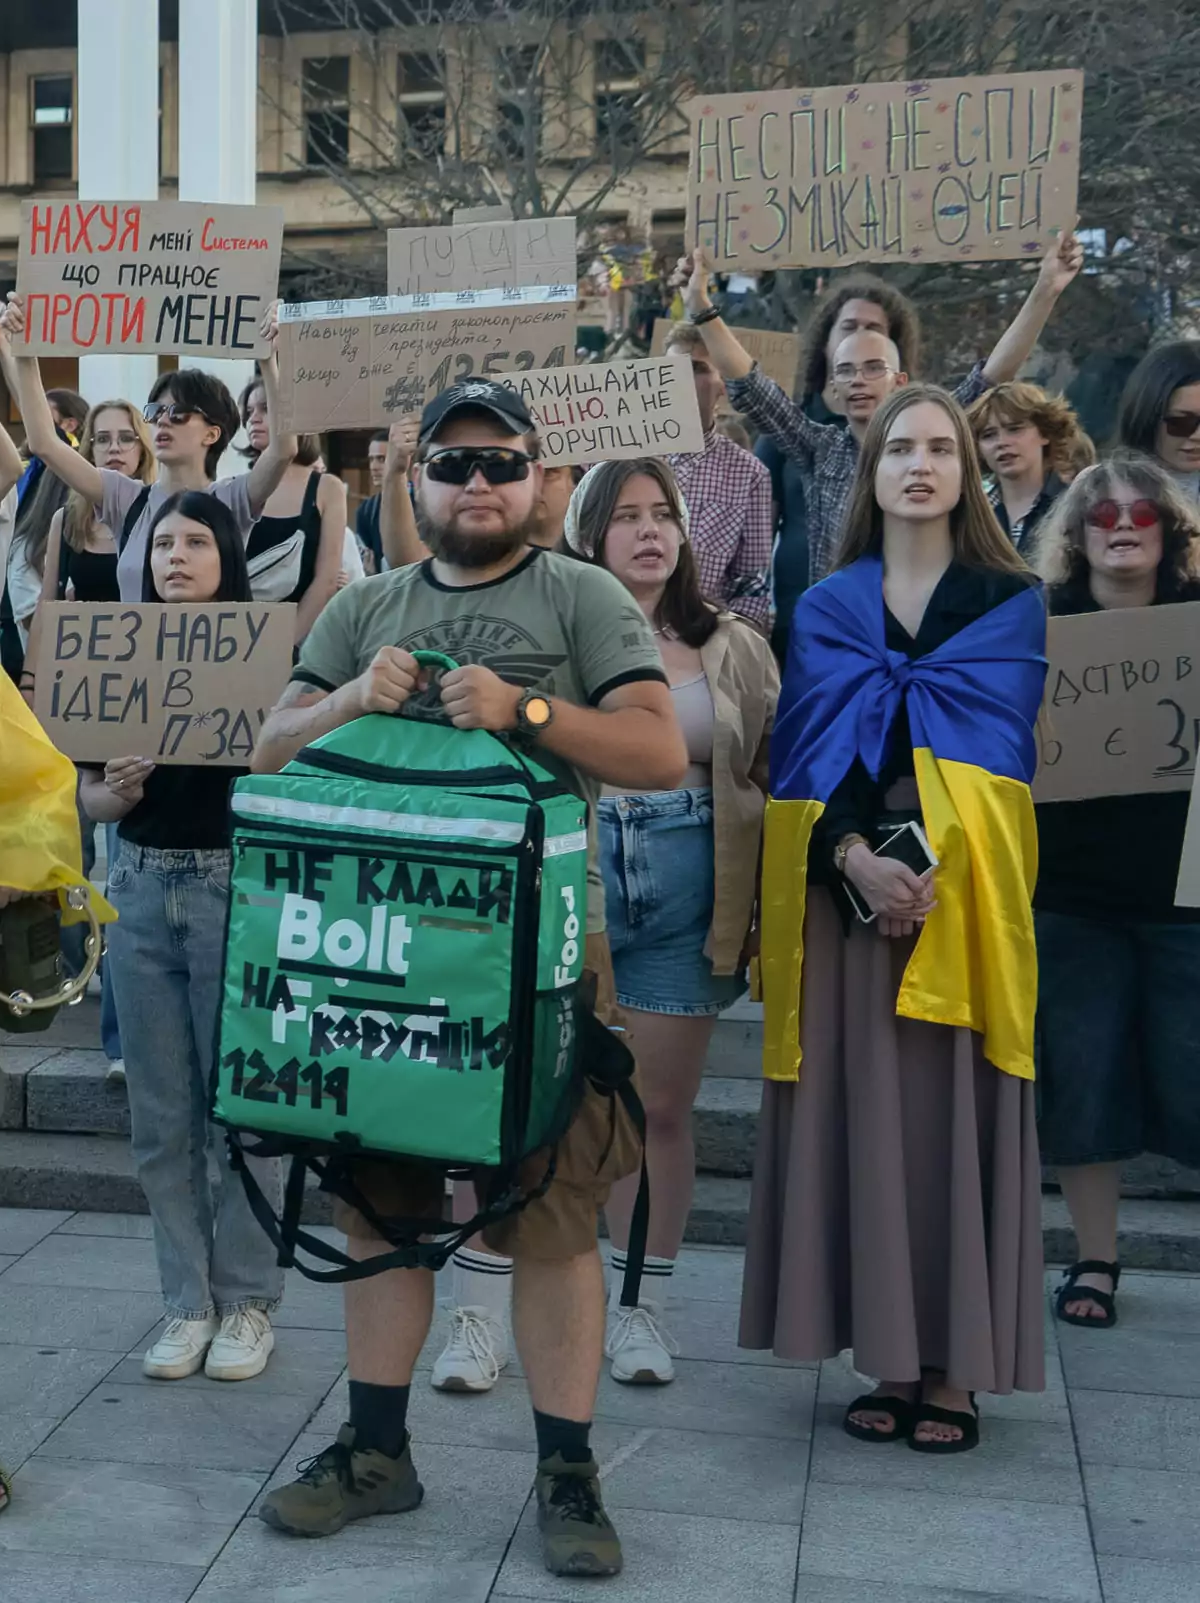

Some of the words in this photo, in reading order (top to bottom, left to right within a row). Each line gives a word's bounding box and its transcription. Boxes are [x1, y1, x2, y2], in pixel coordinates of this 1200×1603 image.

[887, 97, 931, 173] НЕ
[953, 84, 1058, 167] СПИ
[30, 204, 141, 255] НАХУЯ
[695, 190, 739, 259] НЕ
[749, 173, 904, 257] ЗМИКАЙ
[61, 263, 100, 288] ЩО
[118, 264, 220, 288] ПРАЦЮЄ
[25, 293, 148, 347] ПРОТИ
[155, 295, 260, 349] МЕНЕ
[373, 317, 438, 339] чекати
[358, 361, 393, 380] вже
[529, 397, 609, 428] АЦІЮ,
[617, 397, 631, 417] А
[642, 390, 672, 413] НЕ
[55, 610, 143, 662] БЕЗ
[156, 611, 270, 663] НАБУ
[162, 668, 194, 708] В
[1052, 658, 1160, 707] ДСТВО
[1176, 656, 1192, 681] В
[265, 850, 335, 902] НЕ
[356, 856, 514, 924] КЛАДИ
[276, 892, 412, 974] Bolt
[554, 885, 579, 988] Food
[241, 961, 296, 1015] НА
